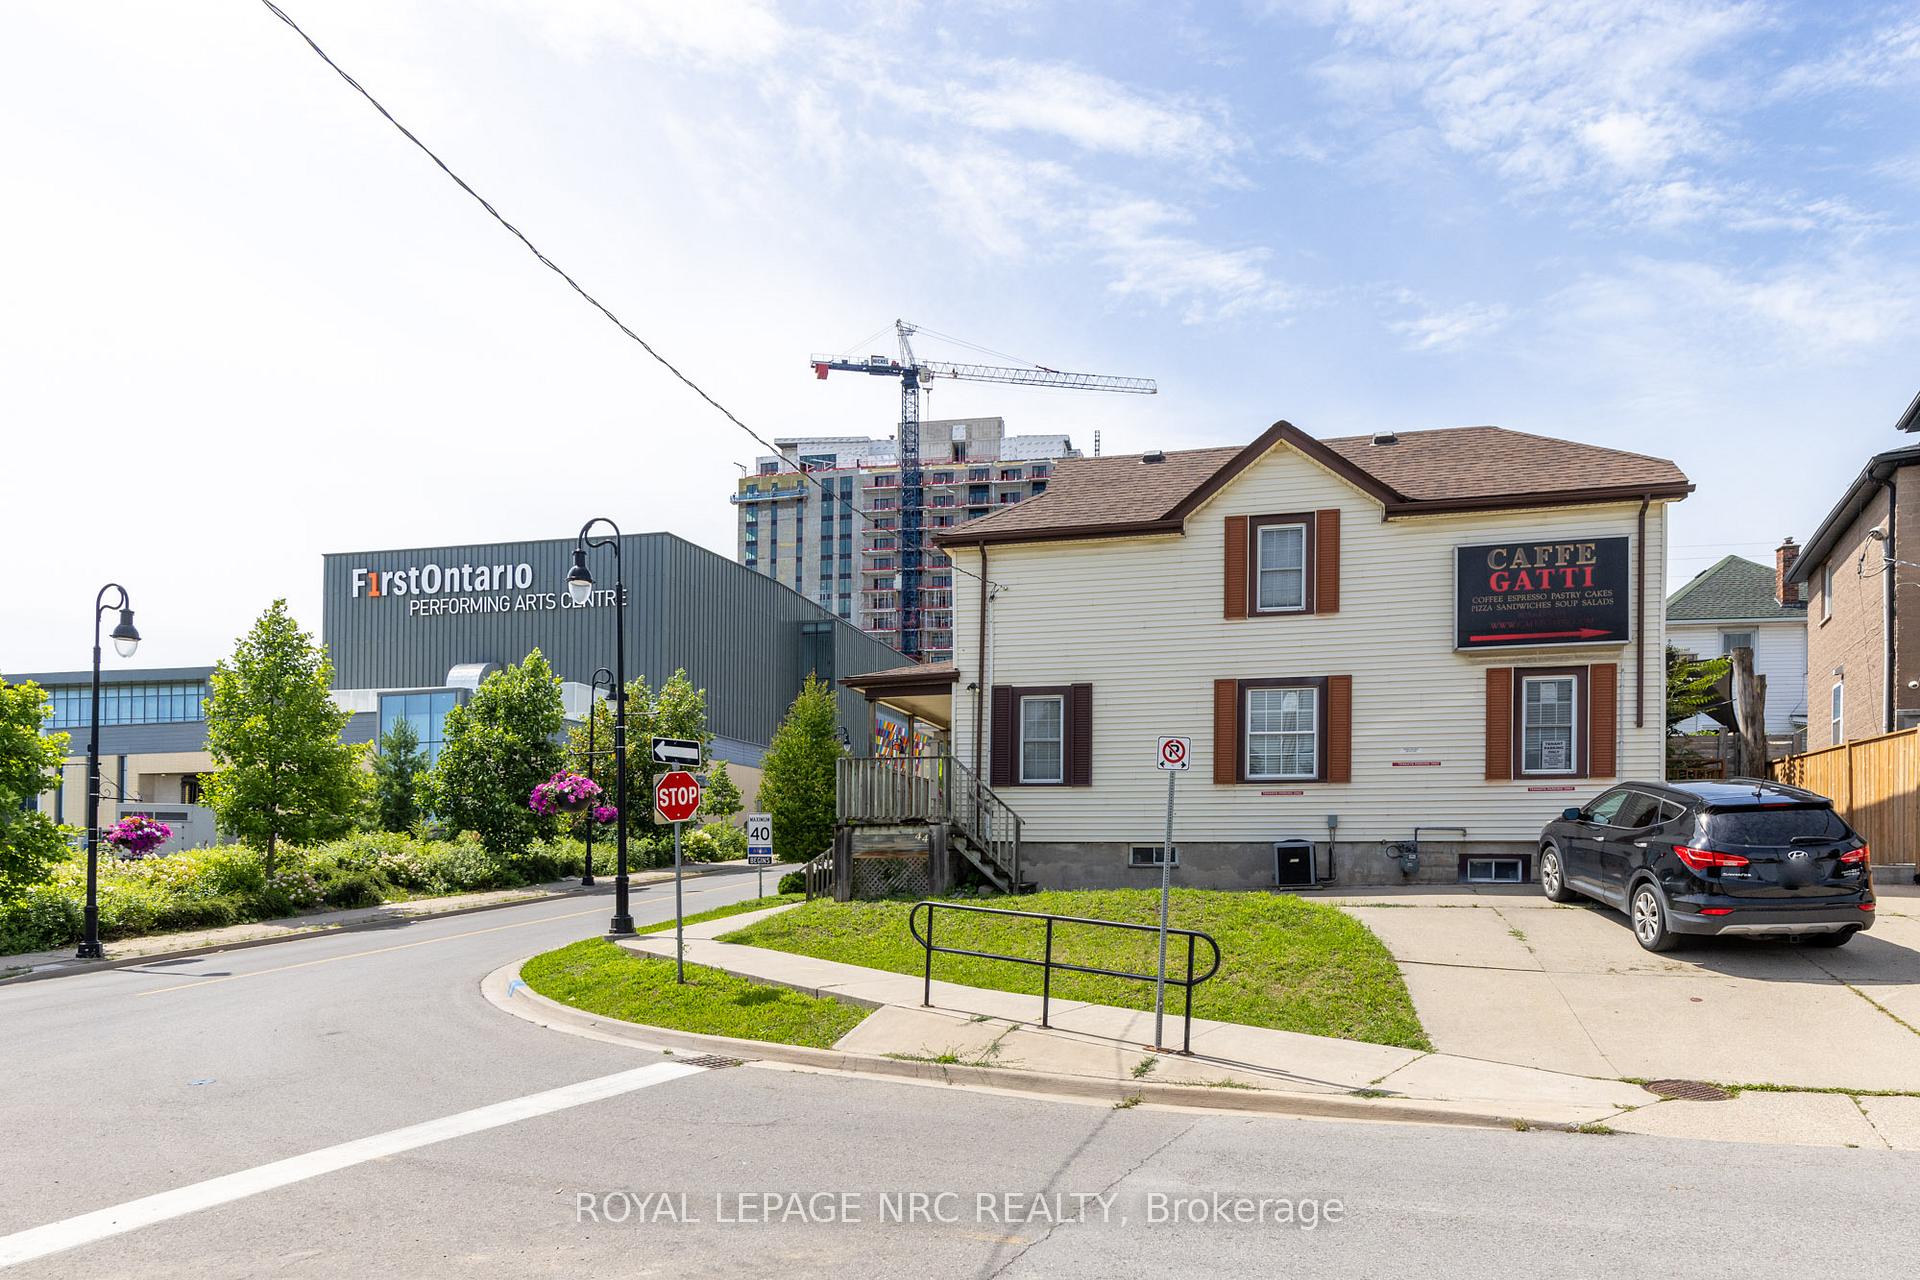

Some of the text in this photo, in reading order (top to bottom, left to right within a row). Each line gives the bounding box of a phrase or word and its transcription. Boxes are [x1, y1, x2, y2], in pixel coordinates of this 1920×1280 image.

[1487, 543, 1597, 570] CAFFE
[1489, 566, 1595, 593] GATTI
[409, 589, 627, 617] PERFORMING ARTS CNTR
[1471, 598, 1614, 612] PIZZA SANDWICHES SOUP SALADS
[1472, 589, 1613, 604] COFFEE ESPRESSO PASTRY CAKES
[659, 786, 698, 807] STOP
[750, 826, 770, 841] 40
